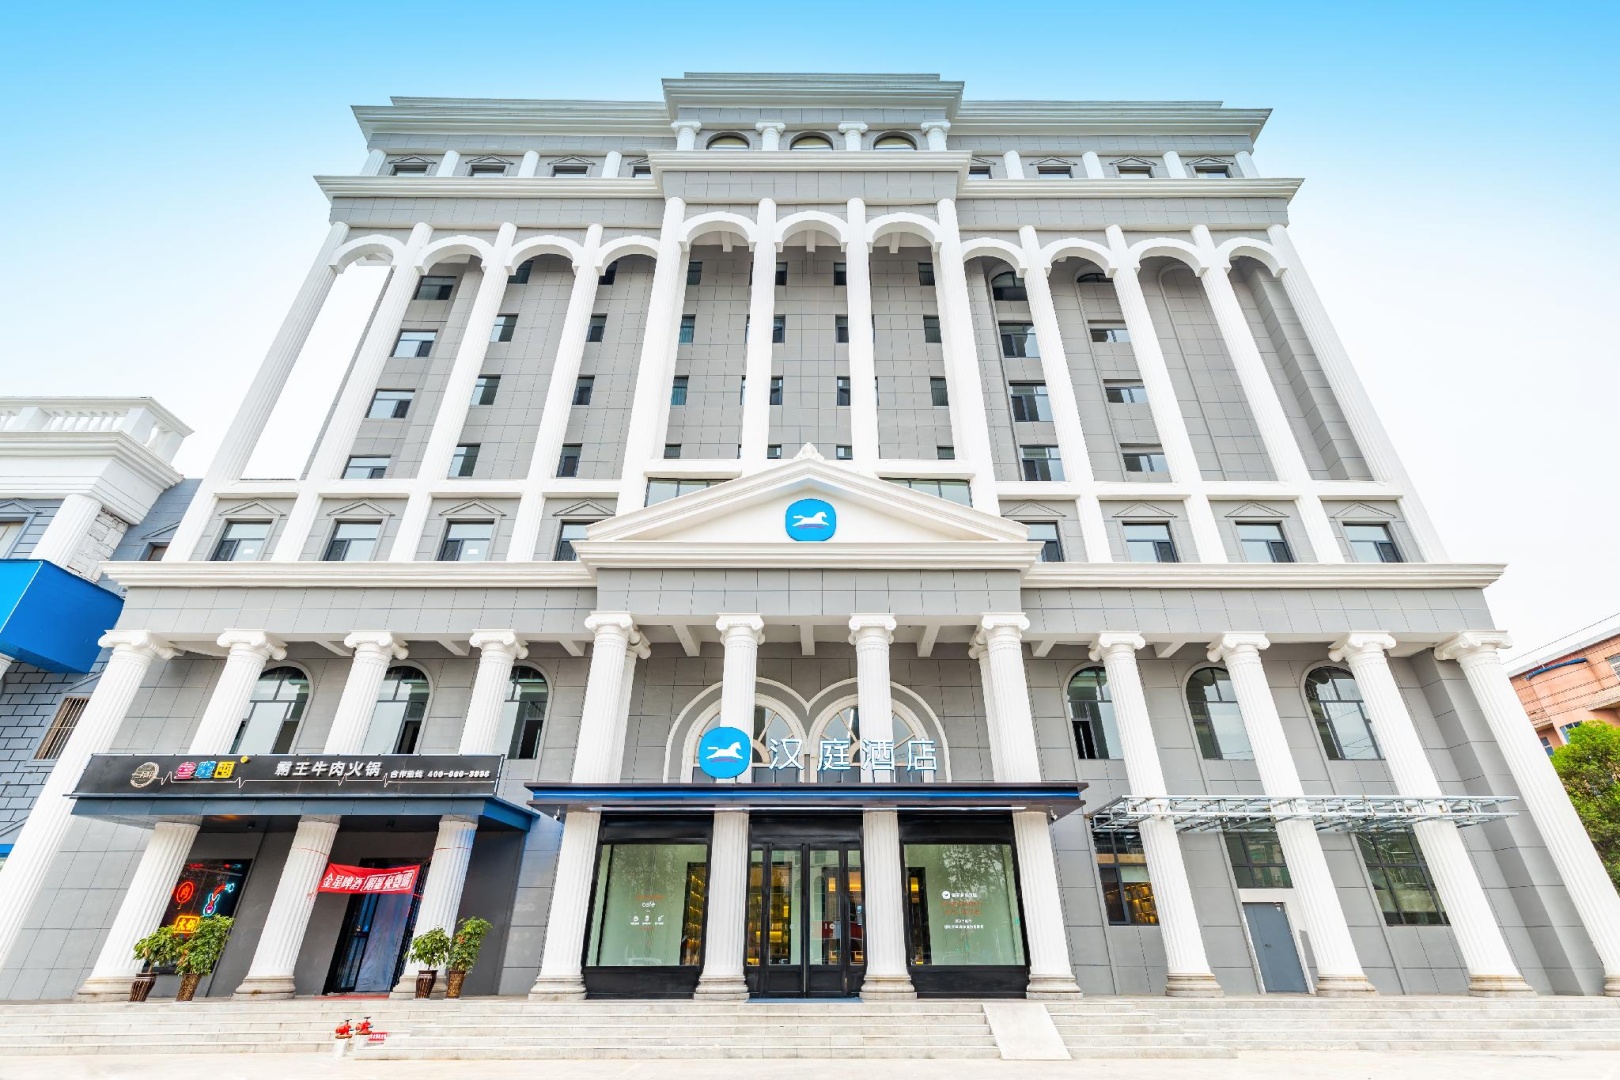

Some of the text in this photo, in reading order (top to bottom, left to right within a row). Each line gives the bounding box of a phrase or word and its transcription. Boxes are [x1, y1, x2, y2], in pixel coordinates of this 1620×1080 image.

[768, 737, 937, 771] 汉庭酒店
[274, 760, 382, 777] 霸王牛肉火锅
[321, 872, 365, 890] 金星啤酒
